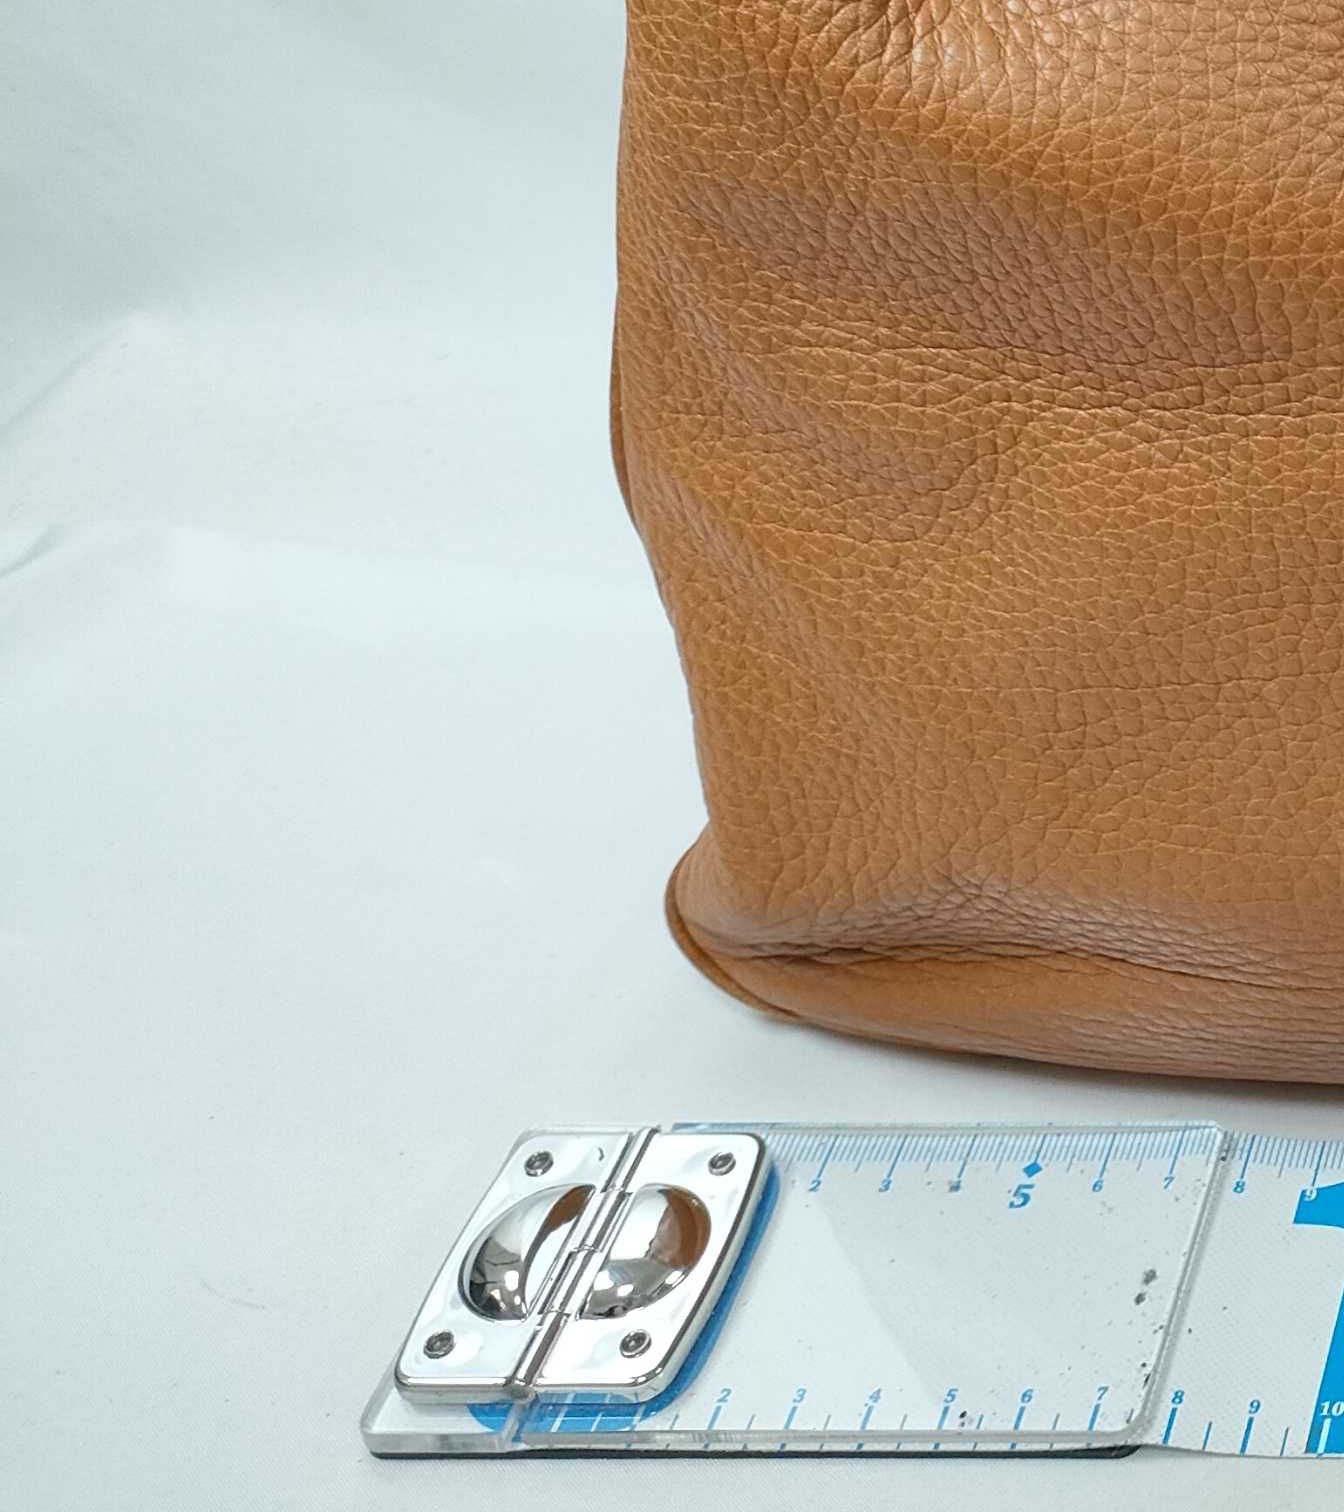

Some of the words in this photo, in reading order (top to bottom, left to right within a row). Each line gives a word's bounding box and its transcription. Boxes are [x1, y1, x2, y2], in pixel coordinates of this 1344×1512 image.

[808, 1179, 822, 1193] 2
[878, 1179, 892, 1193] 3
[948, 1179, 961, 1193] 4
[1009, 1184, 1032, 1208] 5
[1091, 1179, 1104, 1193] 6
[1163, 1179, 1174, 1193] 7
[1233, 1179, 1245, 1195] 8
[1303, 1187, 1317, 1202] 9
[716, 1388, 730, 1403] 2
[793, 1388, 806, 1403] 3
[868, 1388, 881, 1404] 4
[943, 1388, 957, 1403] 5
[1020, 1388, 1033, 1403] 6
[1096, 1388, 1109, 1403] 7
[1170, 1390, 1184, 1405] 8
[1248, 1399, 1261, 1415] 9
[1320, 1401, 1344, 1416] 10
